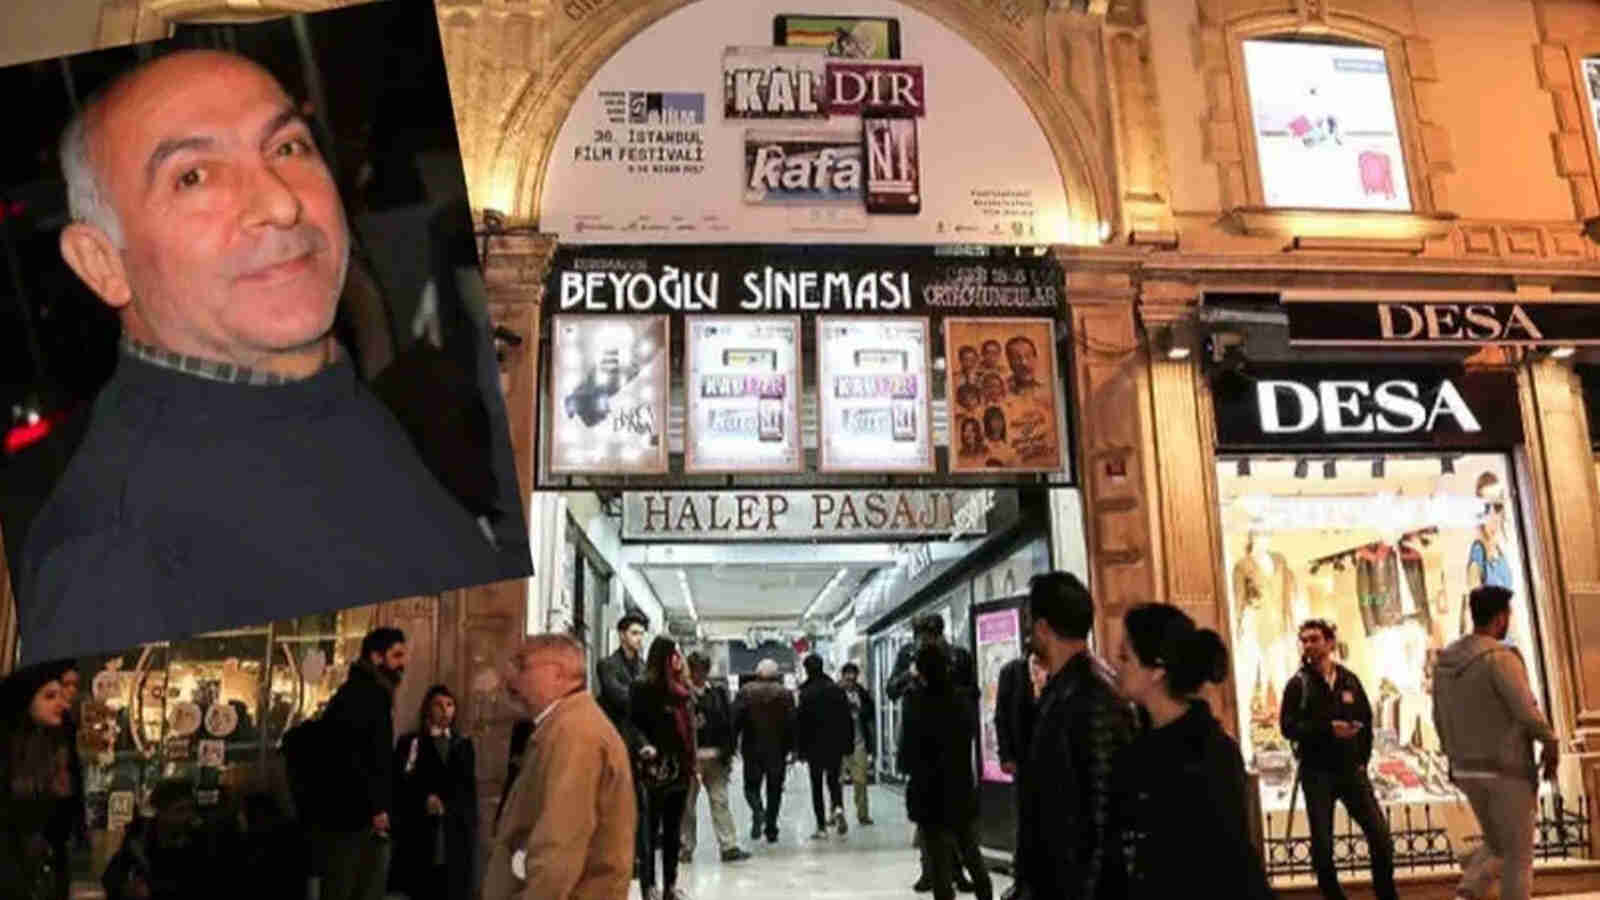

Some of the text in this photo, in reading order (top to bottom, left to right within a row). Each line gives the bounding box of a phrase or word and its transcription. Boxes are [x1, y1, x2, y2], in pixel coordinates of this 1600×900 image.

[832, 71, 921, 107] DIR
[574, 145, 613, 161] FİLM
[750, 145, 862, 190] kafa
[560, 265, 911, 310] BEYOĞLU SİNEMASI
[1378, 304, 1543, 340] DESA
[1257, 379, 1482, 434] DESA
[644, 495, 789, 531] HALEP
